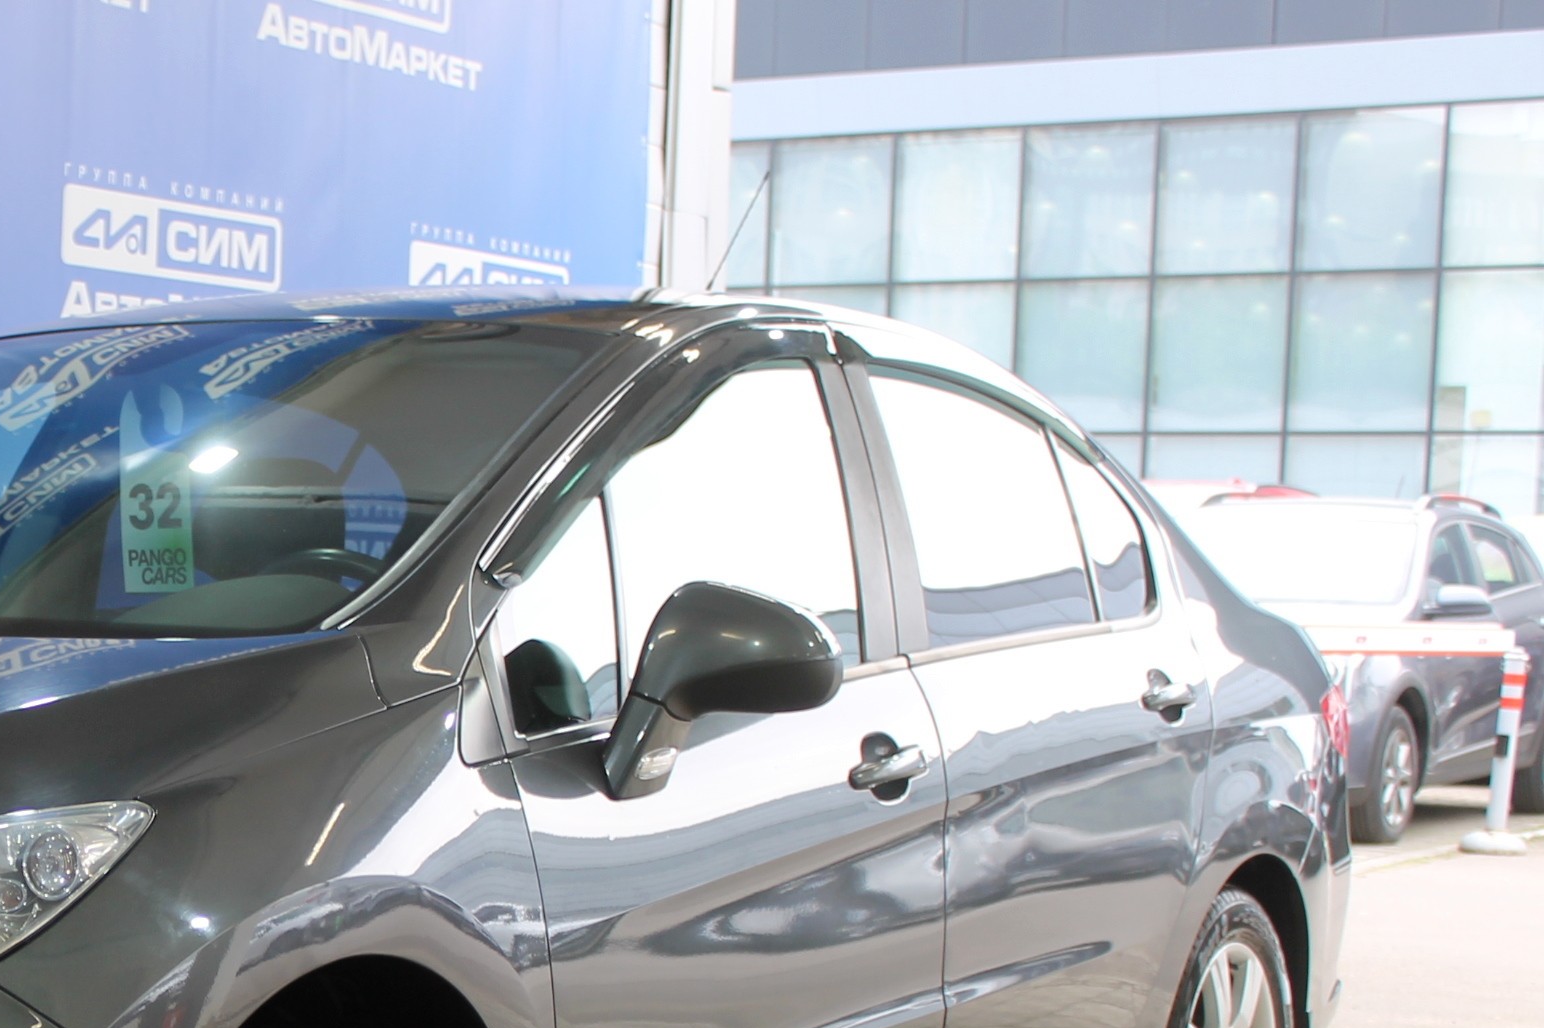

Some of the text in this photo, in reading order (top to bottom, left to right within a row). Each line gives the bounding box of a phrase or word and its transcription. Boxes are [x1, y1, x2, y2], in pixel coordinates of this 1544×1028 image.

[64, 162, 148, 190] ГРУППА
[166, 220, 268, 273] СИМ
[128, 482, 183, 531] 32
[127, 548, 187, 567] PANGO
[141, 566, 188, 585] CARS
